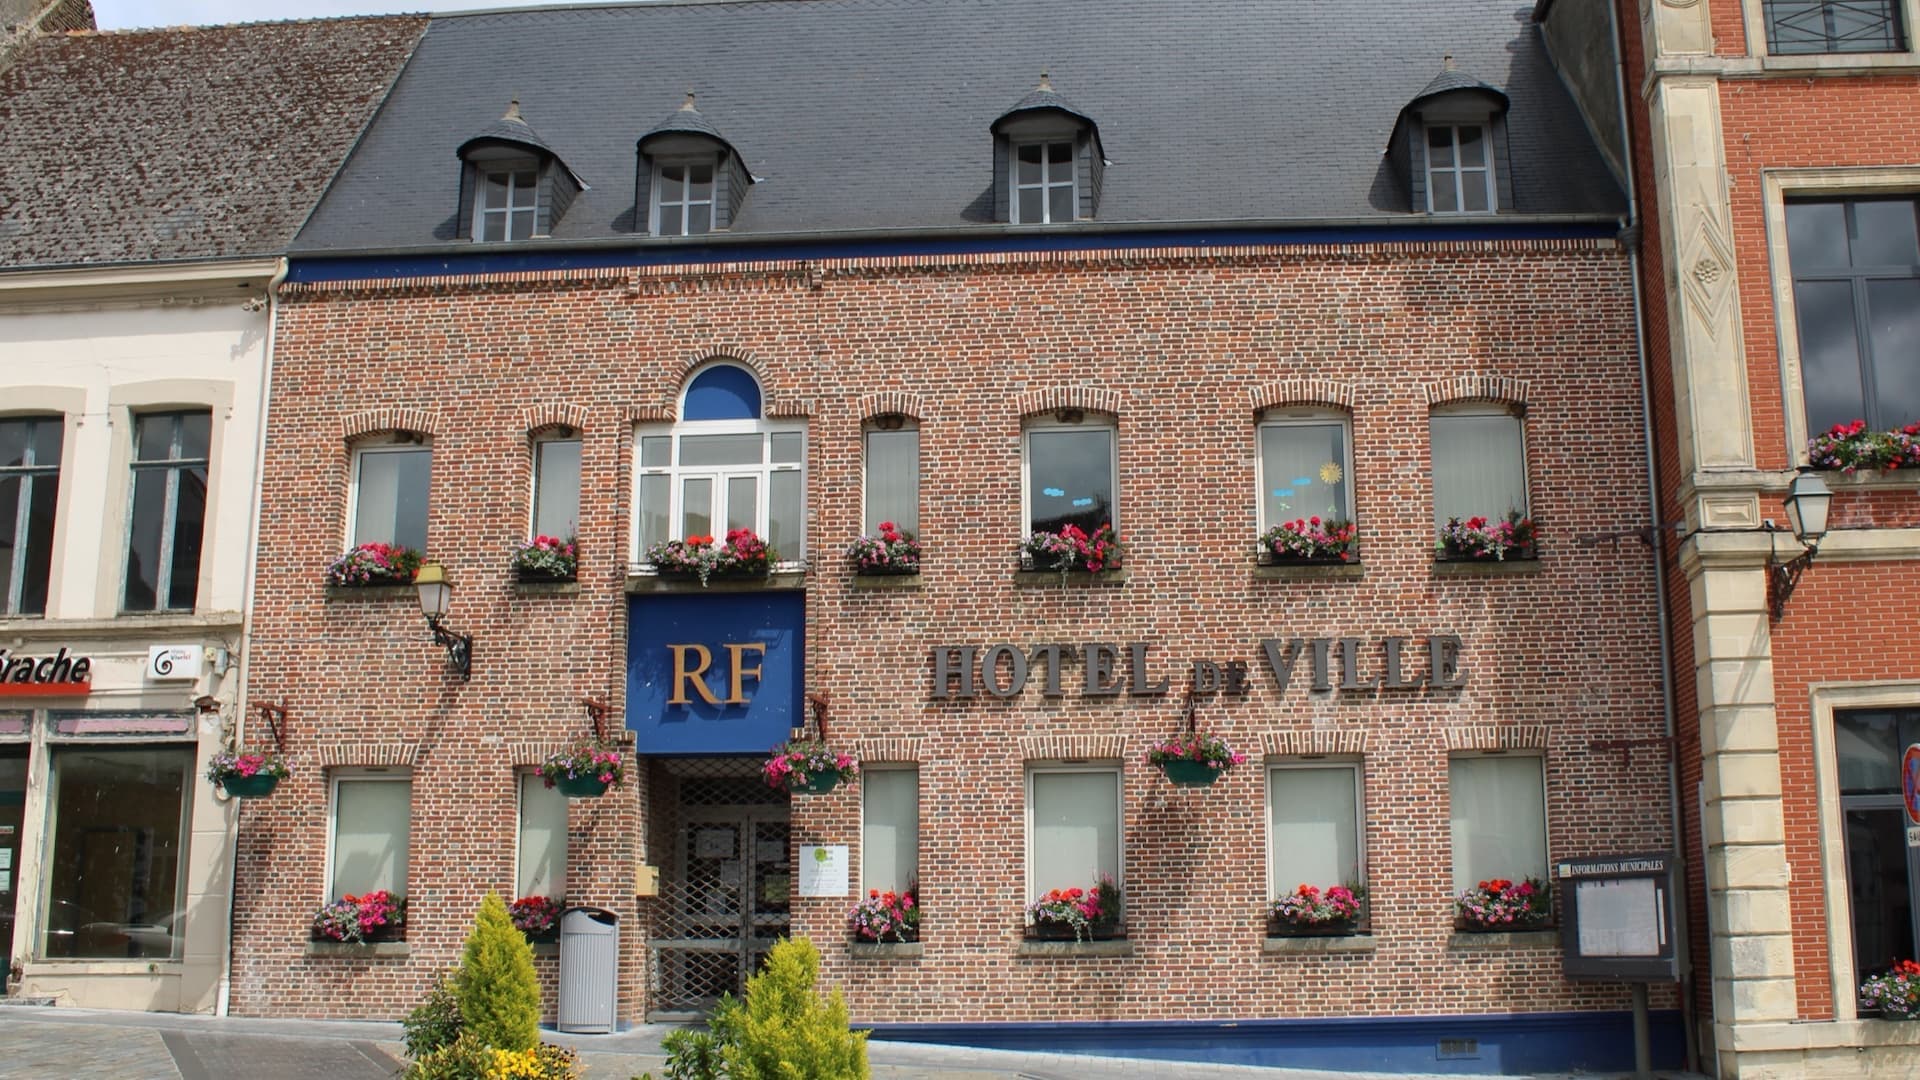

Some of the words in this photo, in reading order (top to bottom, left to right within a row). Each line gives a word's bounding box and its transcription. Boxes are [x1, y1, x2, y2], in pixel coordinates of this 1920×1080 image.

[665, 642, 767, 705] RF
[930, 642, 1170, 698] HOTEL
[1193, 660, 1251, 695] DE
[1262, 634, 1470, 692] VILLE
[1571, 863, 1619, 875] INFORMATIONS
[1619, 860, 1664, 872] MUNICIPALES
